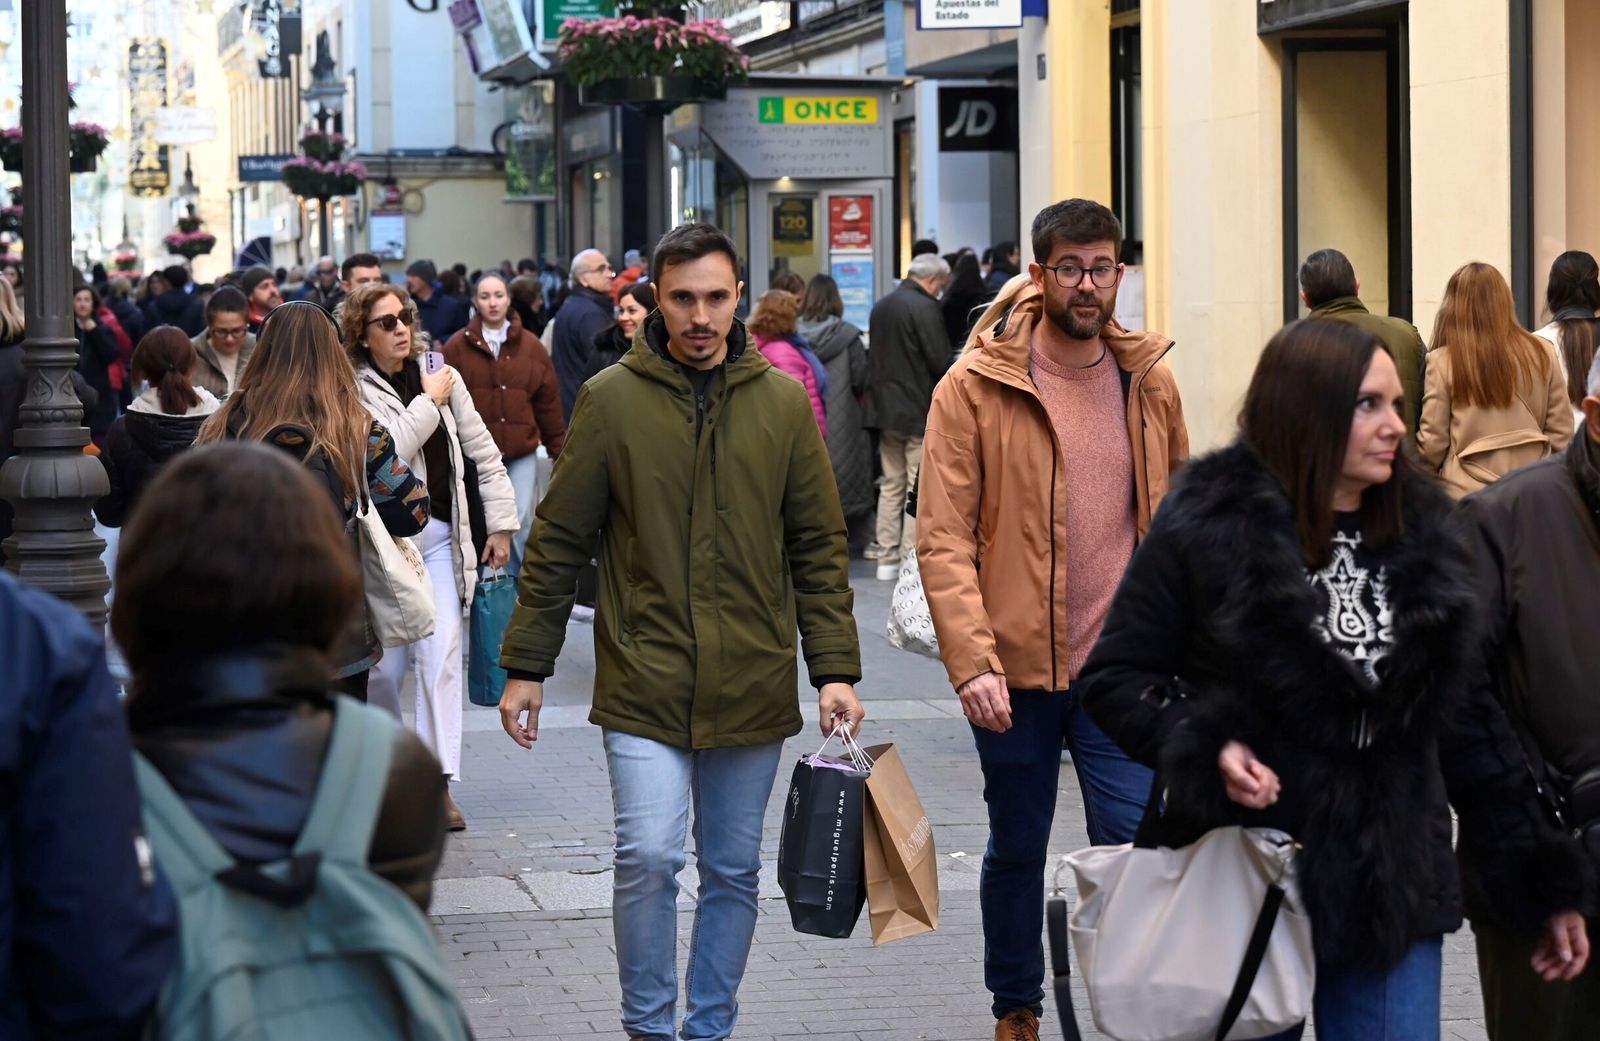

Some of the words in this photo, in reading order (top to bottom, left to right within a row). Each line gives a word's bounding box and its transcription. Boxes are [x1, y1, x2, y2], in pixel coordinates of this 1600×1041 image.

[936, 0, 981, 8] Apuestas
[936, 11, 969, 20] Estado
[794, 100, 867, 119] ONCE
[945, 101, 997, 138] JD
[826, 790, 845, 910] www.miguelperis.com
